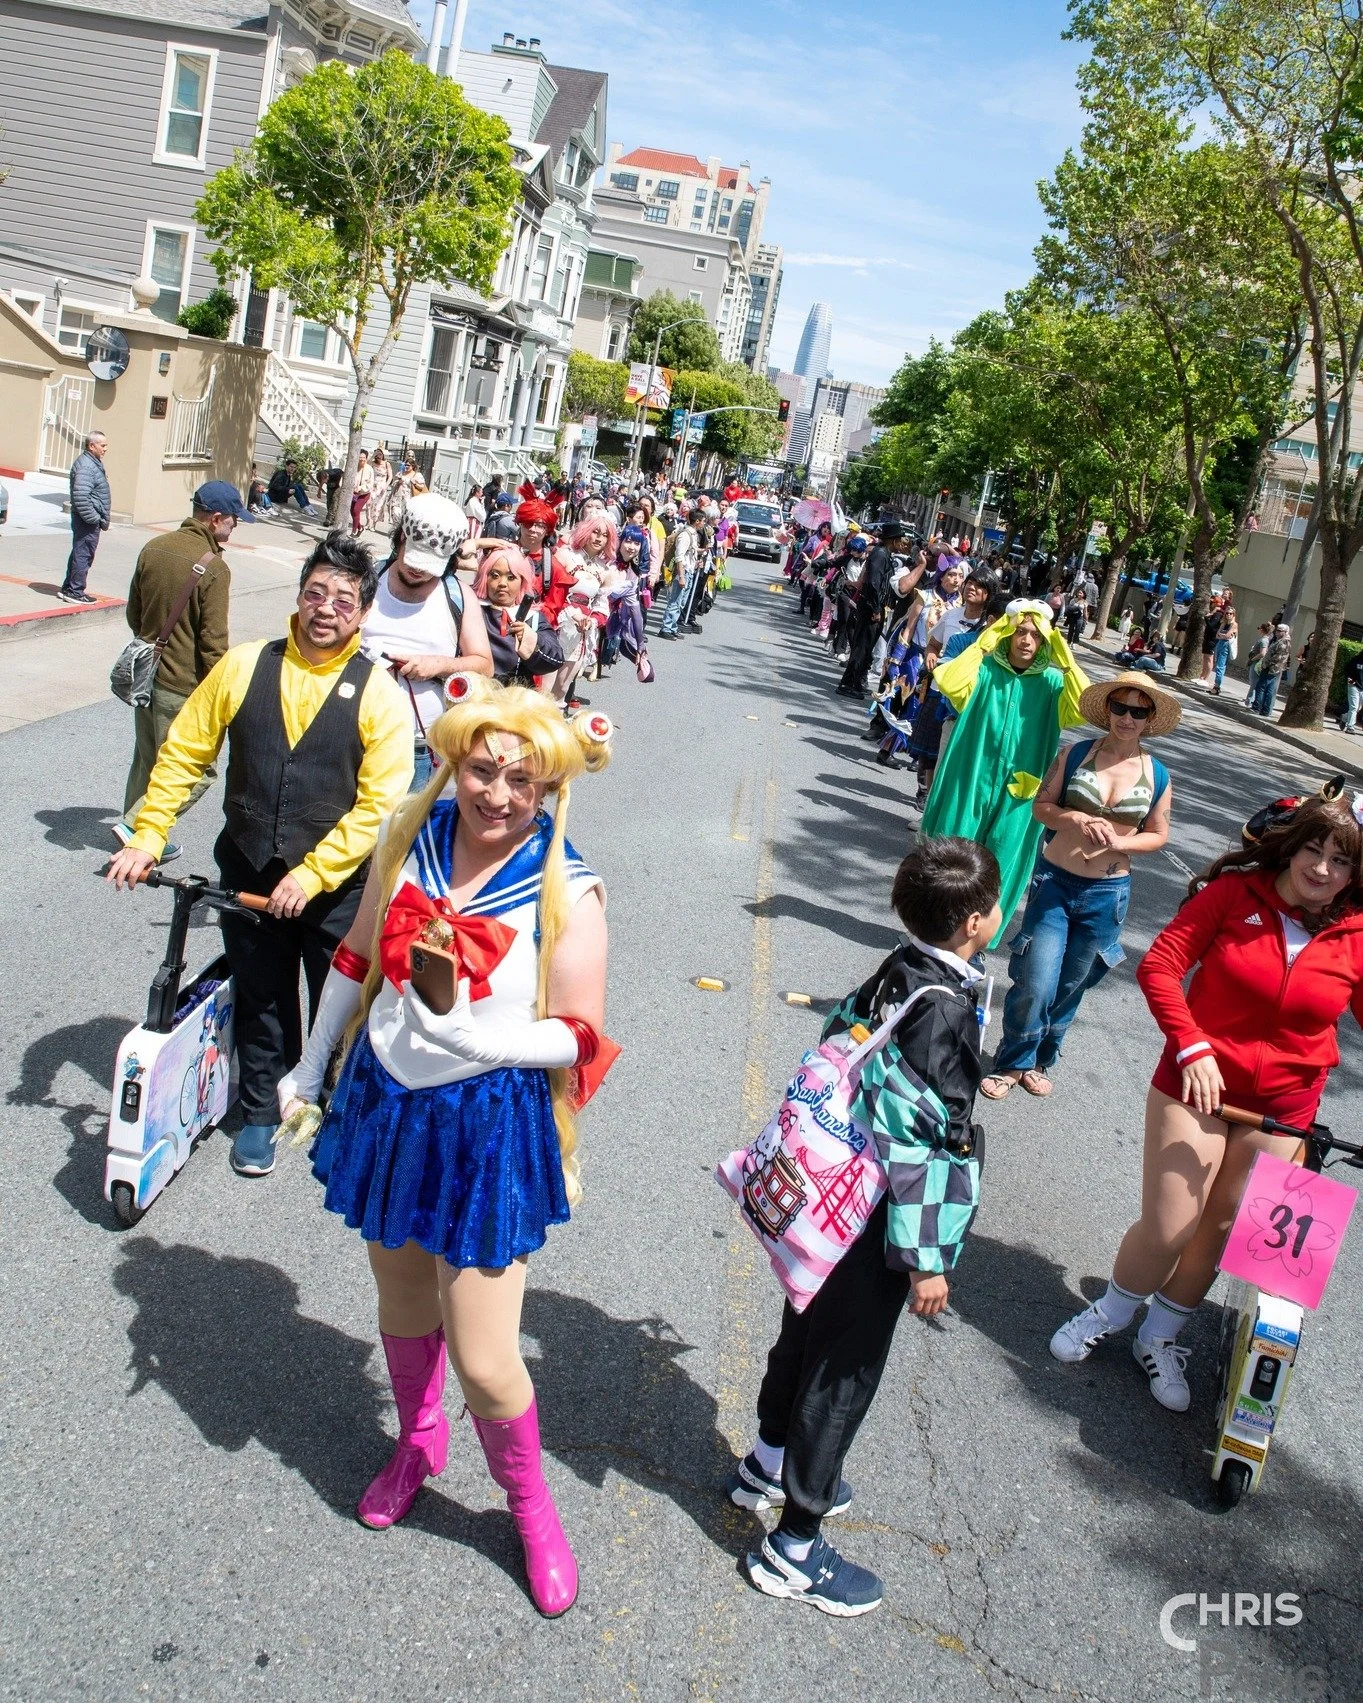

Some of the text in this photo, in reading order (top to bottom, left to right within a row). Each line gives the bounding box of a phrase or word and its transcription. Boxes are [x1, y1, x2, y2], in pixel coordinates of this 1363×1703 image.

[786, 1072, 867, 1155] San Francisco
[1263, 1204, 1314, 1259] 31
